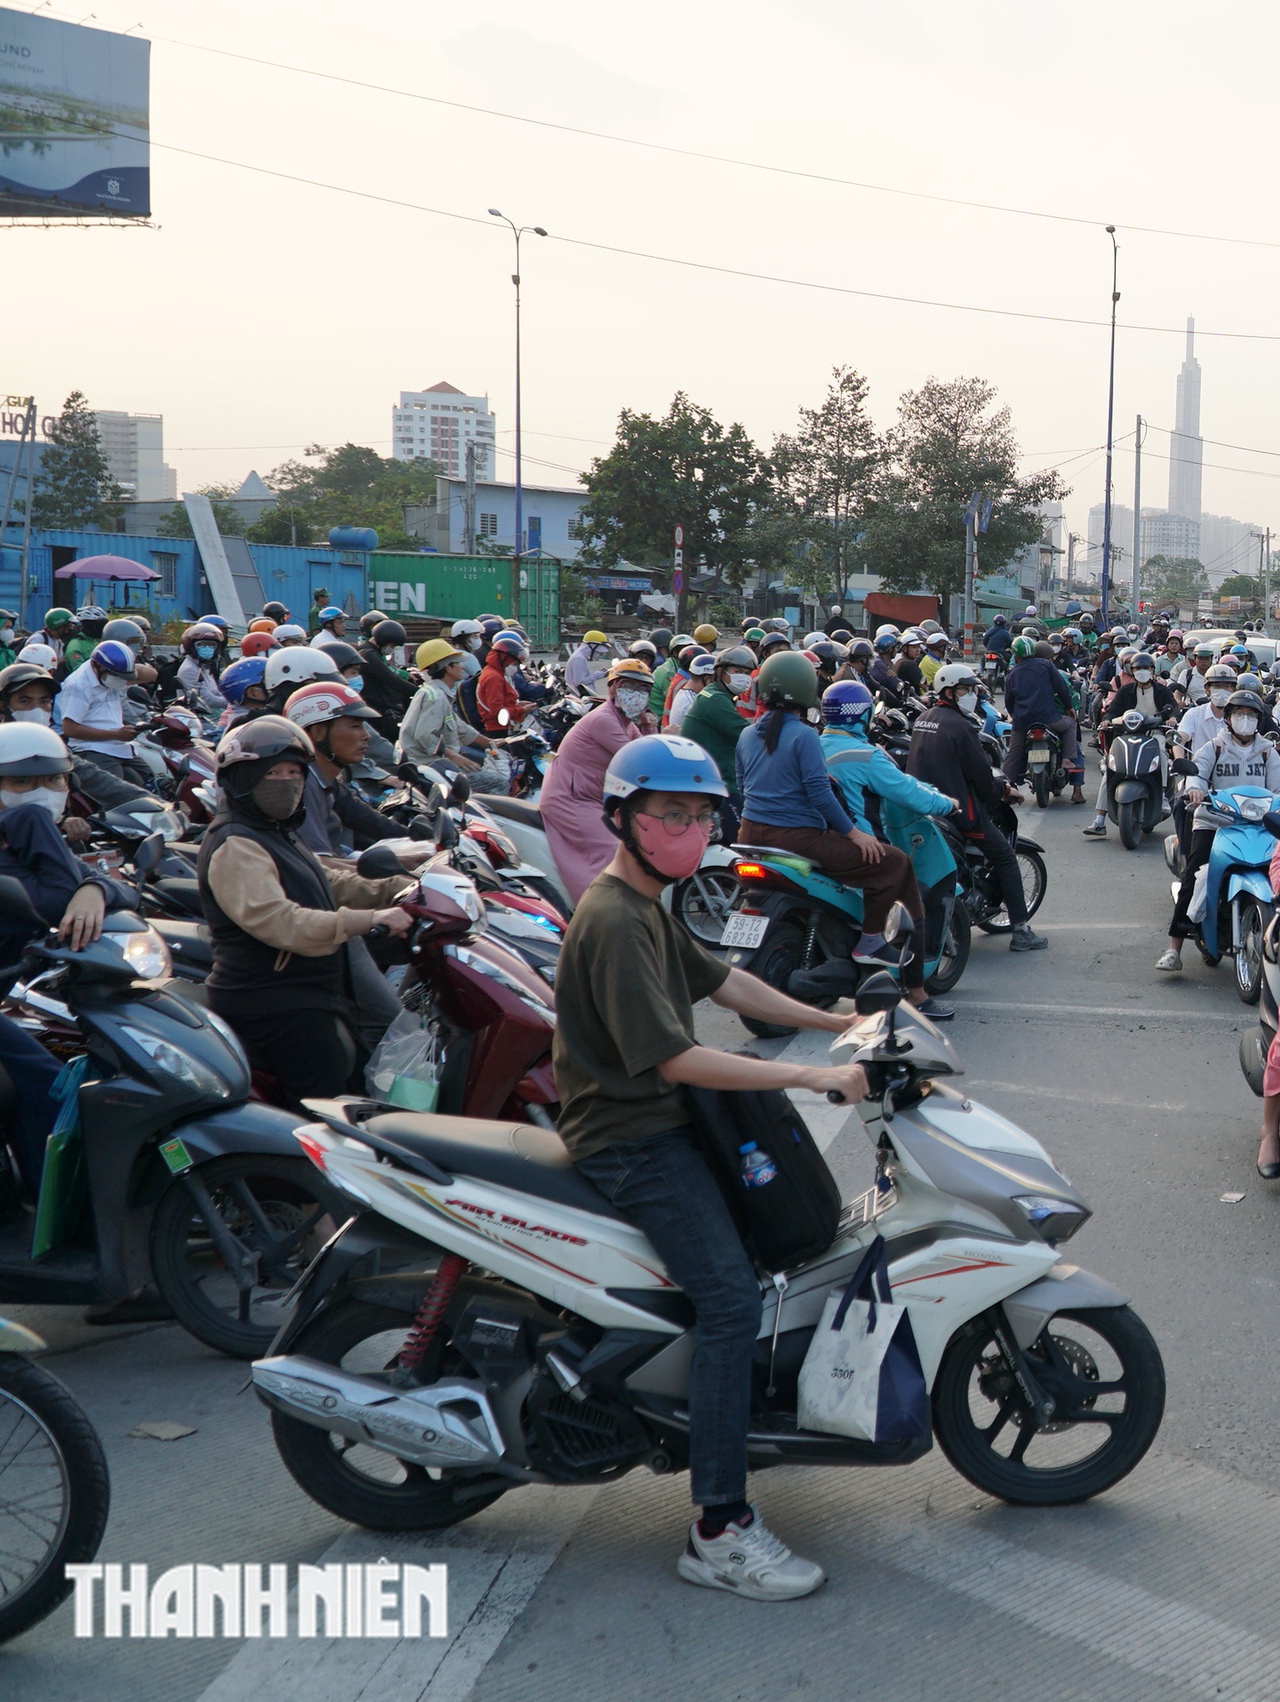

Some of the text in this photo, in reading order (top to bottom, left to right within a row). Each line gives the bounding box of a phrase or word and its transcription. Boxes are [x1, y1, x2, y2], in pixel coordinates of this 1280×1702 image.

[368, 580, 426, 612] EN
[1216, 763, 1240, 777] SAN
[731, 917, 762, 932] 59-T2
[724, 930, 760, 946] 682.69
[500, 1214, 588, 1247] BLADE
[963, 1250, 1003, 1261] HONDA
[994, 1329, 1015, 1370] SPECIAL
